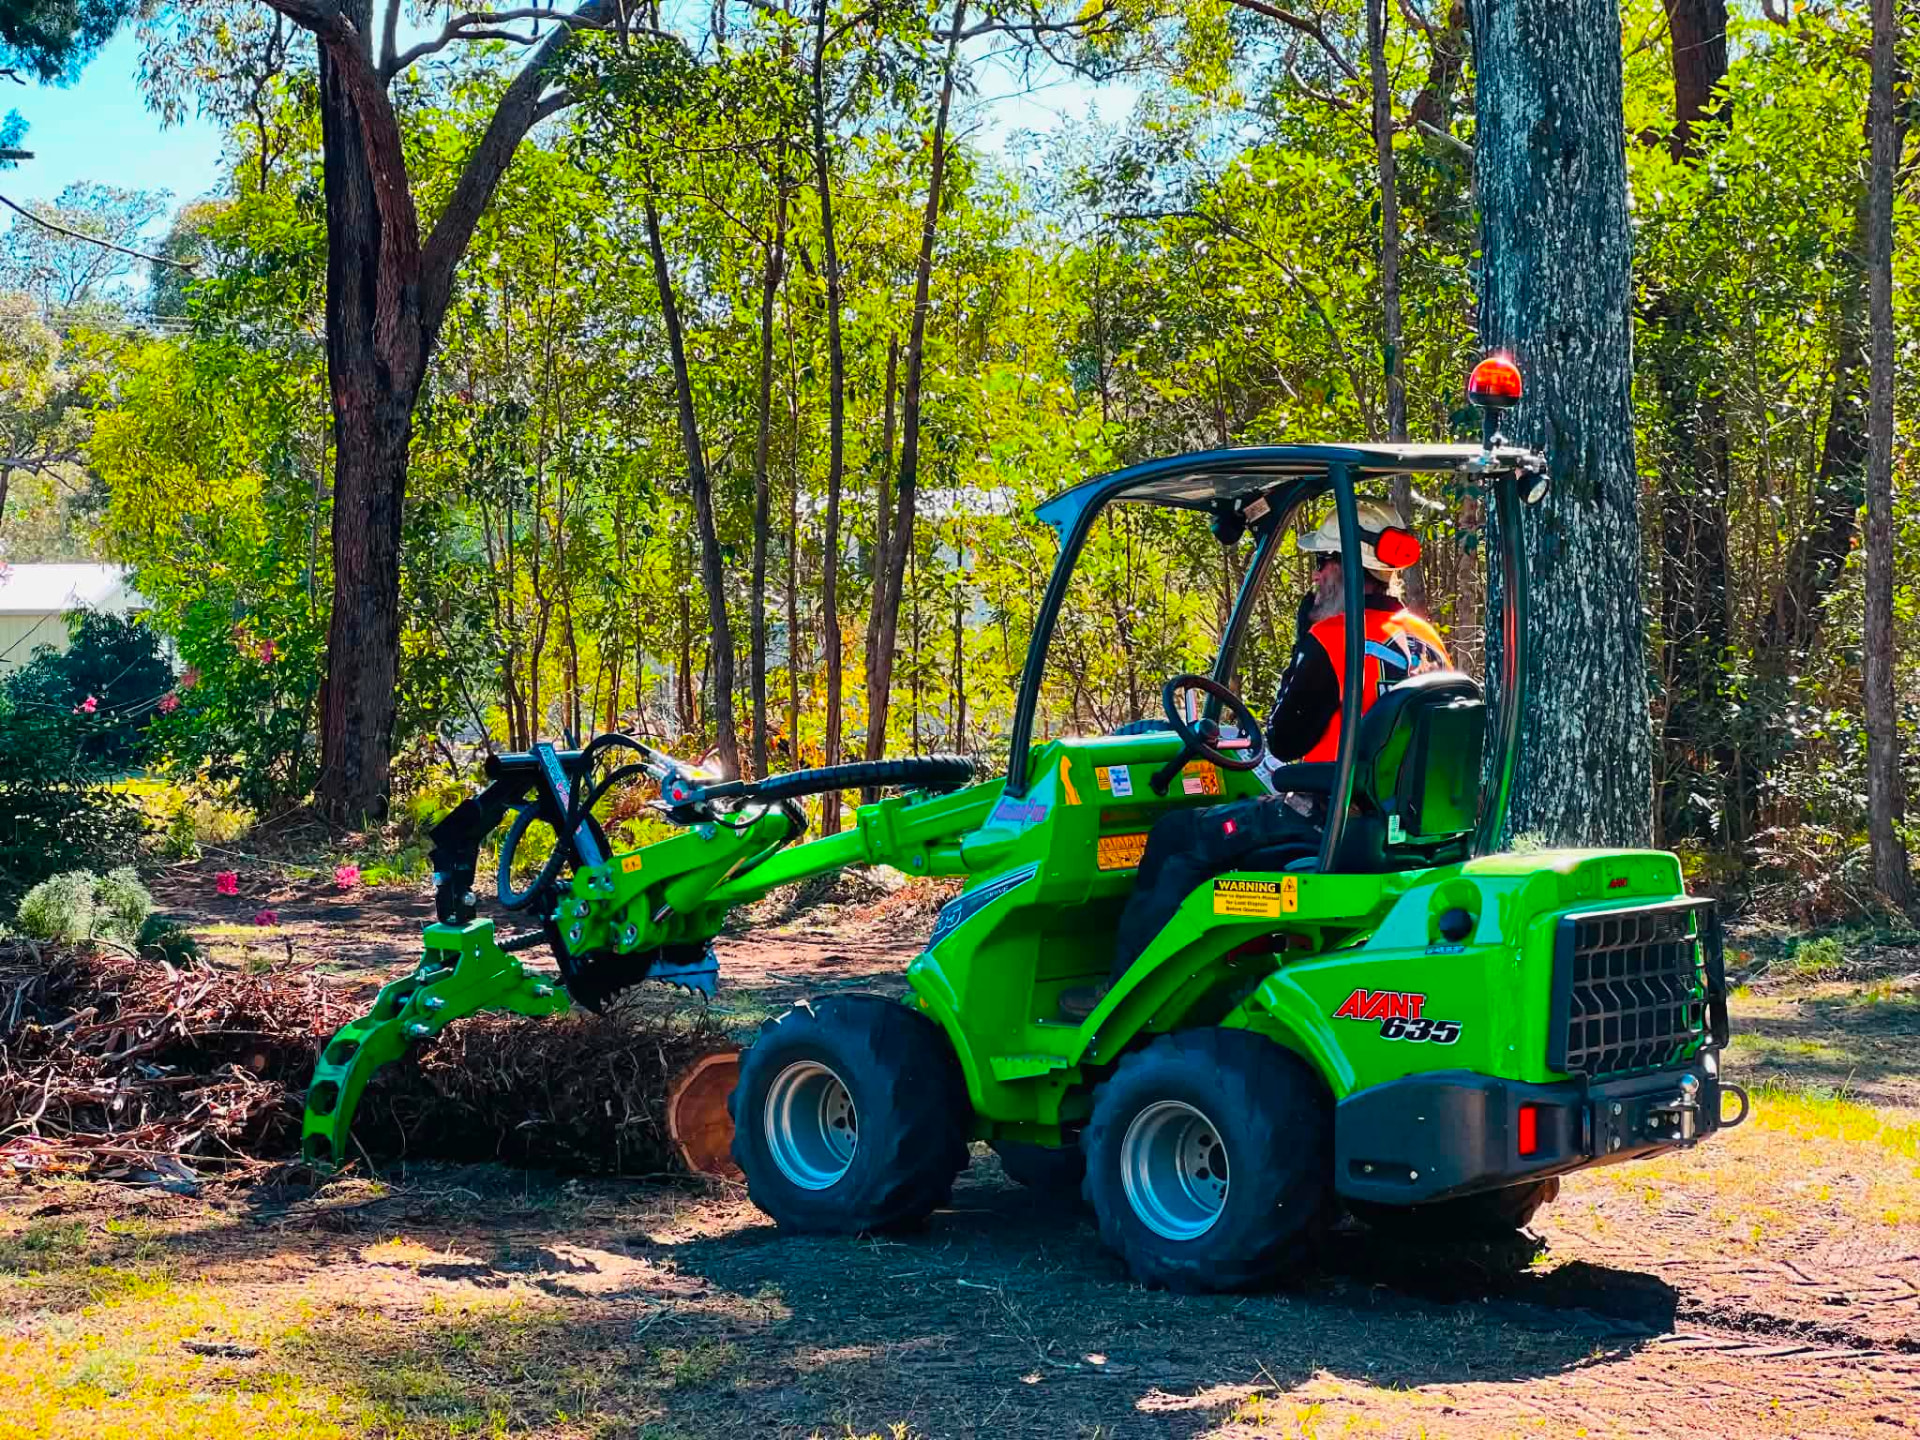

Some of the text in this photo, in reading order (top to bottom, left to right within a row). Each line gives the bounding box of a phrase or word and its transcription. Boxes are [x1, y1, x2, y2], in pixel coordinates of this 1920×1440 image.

[1218, 880, 1276, 893] WARNING
[1332, 988, 1427, 1021] AVANT
[1380, 1016, 1463, 1046] 635
